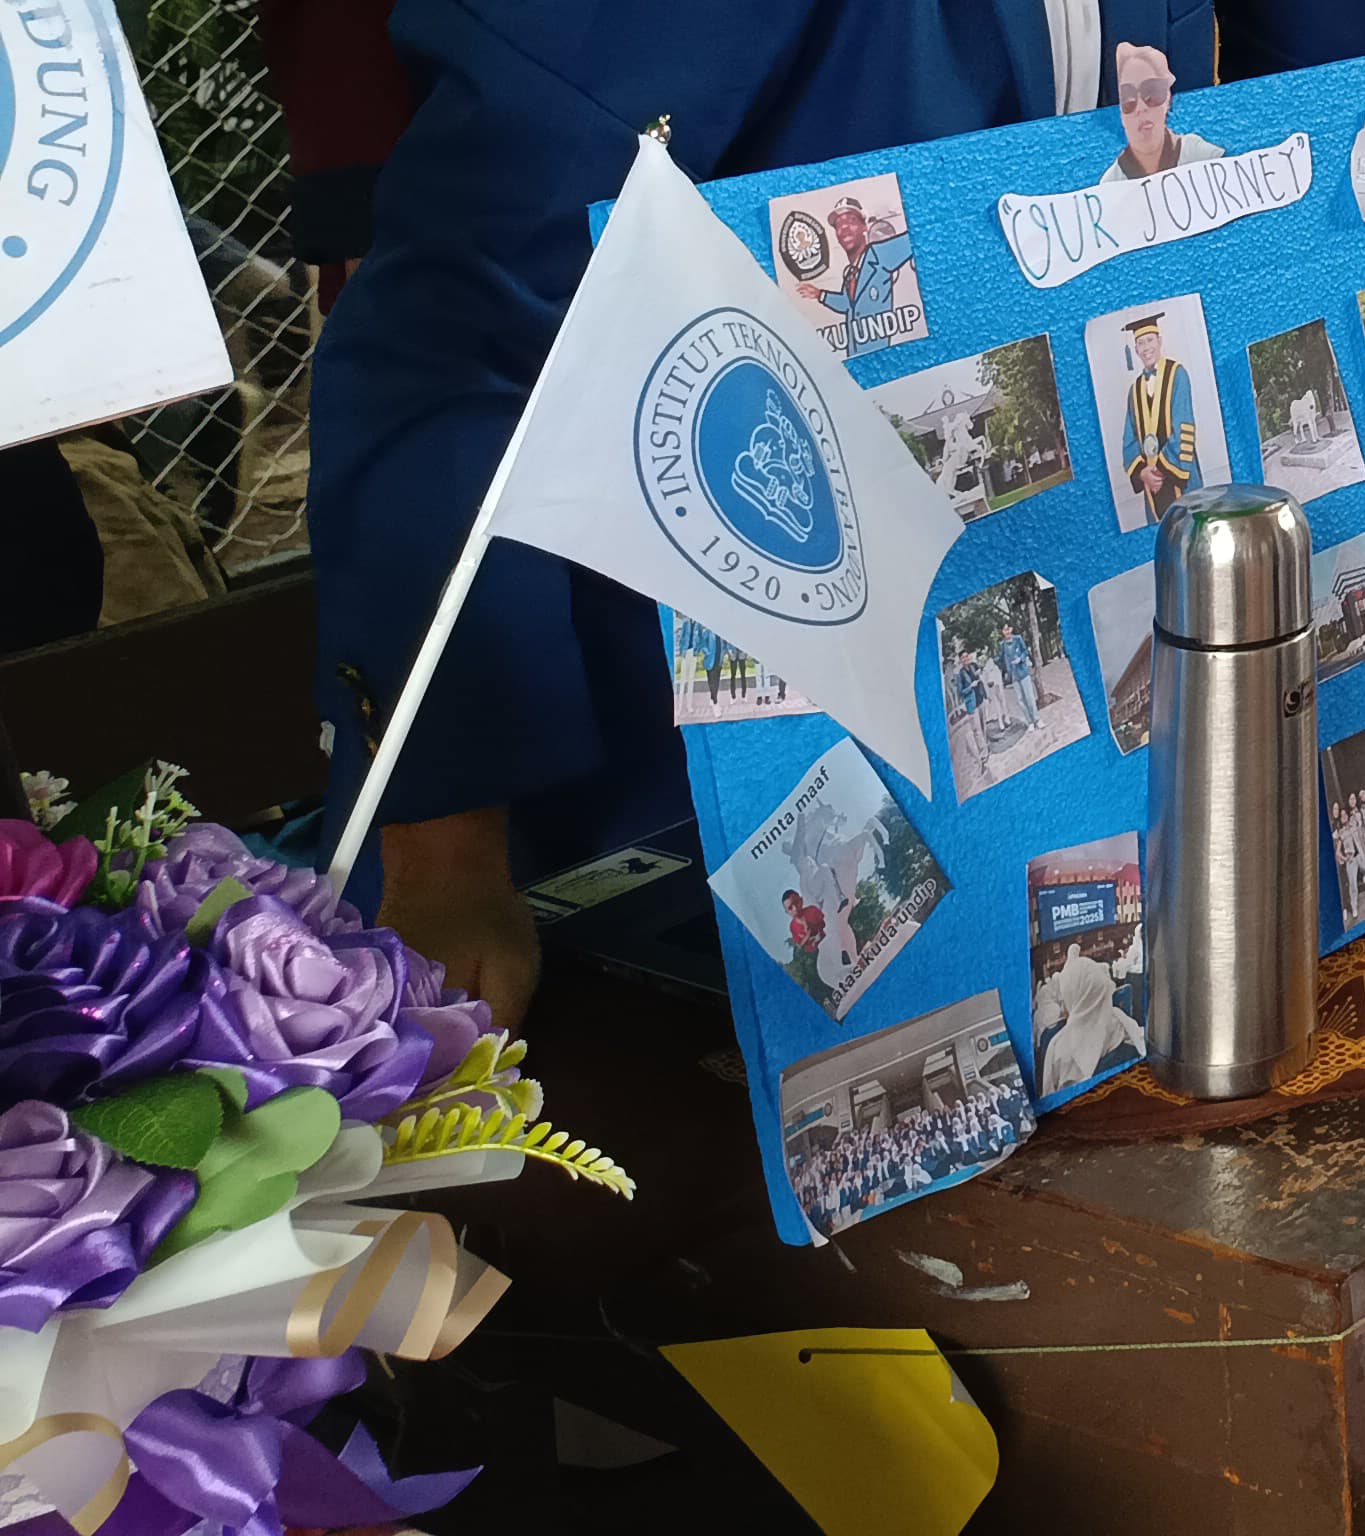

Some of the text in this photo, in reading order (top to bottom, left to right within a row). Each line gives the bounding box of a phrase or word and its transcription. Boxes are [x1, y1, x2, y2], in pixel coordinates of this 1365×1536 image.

[852, 304, 921, 346] UNDIP
[650, 330, 723, 501] INSTITUT
[723, 322, 841, 474] TEKNOLOGI
[701, 535, 781, 601] 1920
[751, 765, 831, 860] minta maaf
[861, 924, 897, 966] kuda
[897, 877, 937, 925] undip
[1052, 904, 1079, 920] PMB
